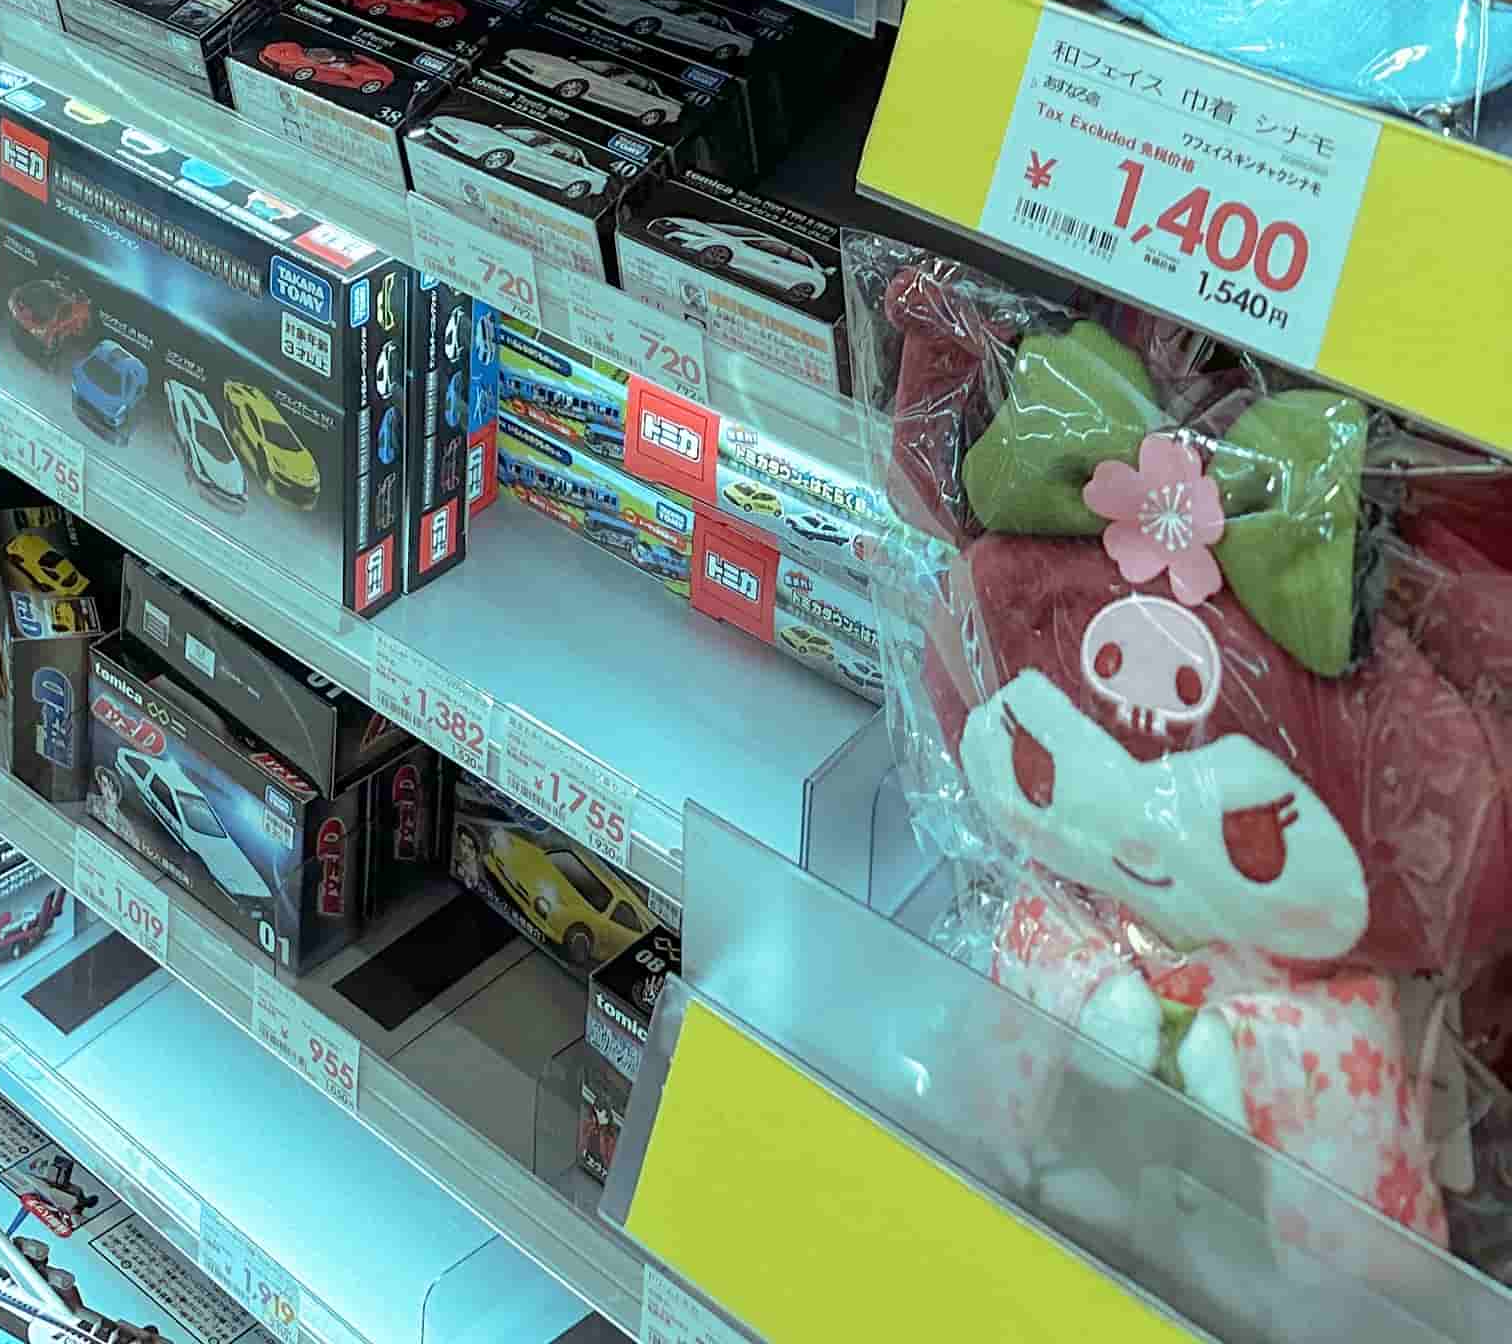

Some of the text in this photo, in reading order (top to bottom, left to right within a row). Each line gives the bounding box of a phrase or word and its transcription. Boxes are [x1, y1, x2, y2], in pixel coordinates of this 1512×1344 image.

[1052, 39, 1336, 161] 和フェイス 巾着 シナモ
[1037, 101, 1064, 123] Tax
[1069, 112, 1138, 152] Excluded
[1, 138, 47, 183] トミカ
[1023, 149, 1310, 293] ¥ 1,400
[279, 262, 325, 298] TAKARA
[279, 276, 326, 314] TOMY
[480, 256, 536, 304] 720
[1197, 269, 1290, 330] 1,540円
[640, 334, 701, 385] 720
[642, 410, 703, 463] トミカ
[28, 438, 81, 494] 1,755
[706, 551, 760, 602] トミカ
[93, 661, 144, 706] tomica
[414, 686, 486, 756] 1,382
[548, 770, 626, 845] 1,755
[595, 992, 649, 1044] tomic
[309, 1038, 354, 1091] 955
